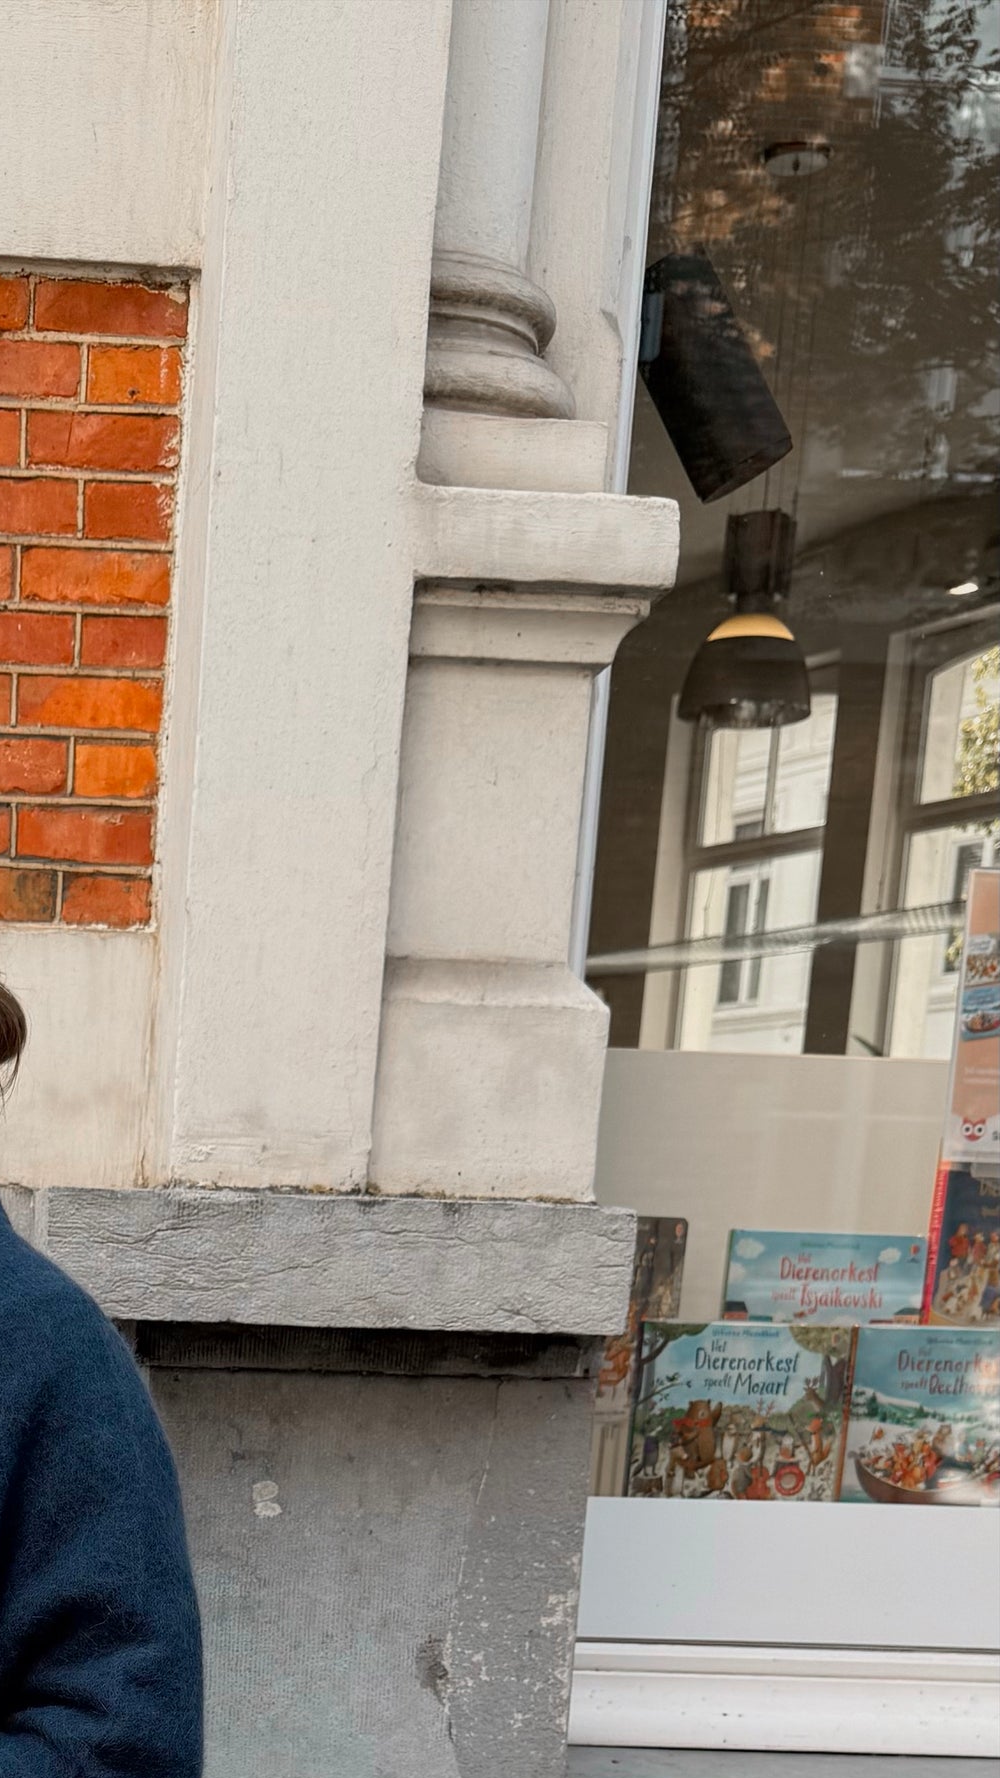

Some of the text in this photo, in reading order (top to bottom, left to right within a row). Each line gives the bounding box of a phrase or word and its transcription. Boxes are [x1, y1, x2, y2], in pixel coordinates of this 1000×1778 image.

[780, 1256, 880, 1283] Dierenorkest
[711, 1340, 727, 1353] Het
[695, 1347, 799, 1373] Dierenorkest
[733, 1373, 789, 1396] Mozart
